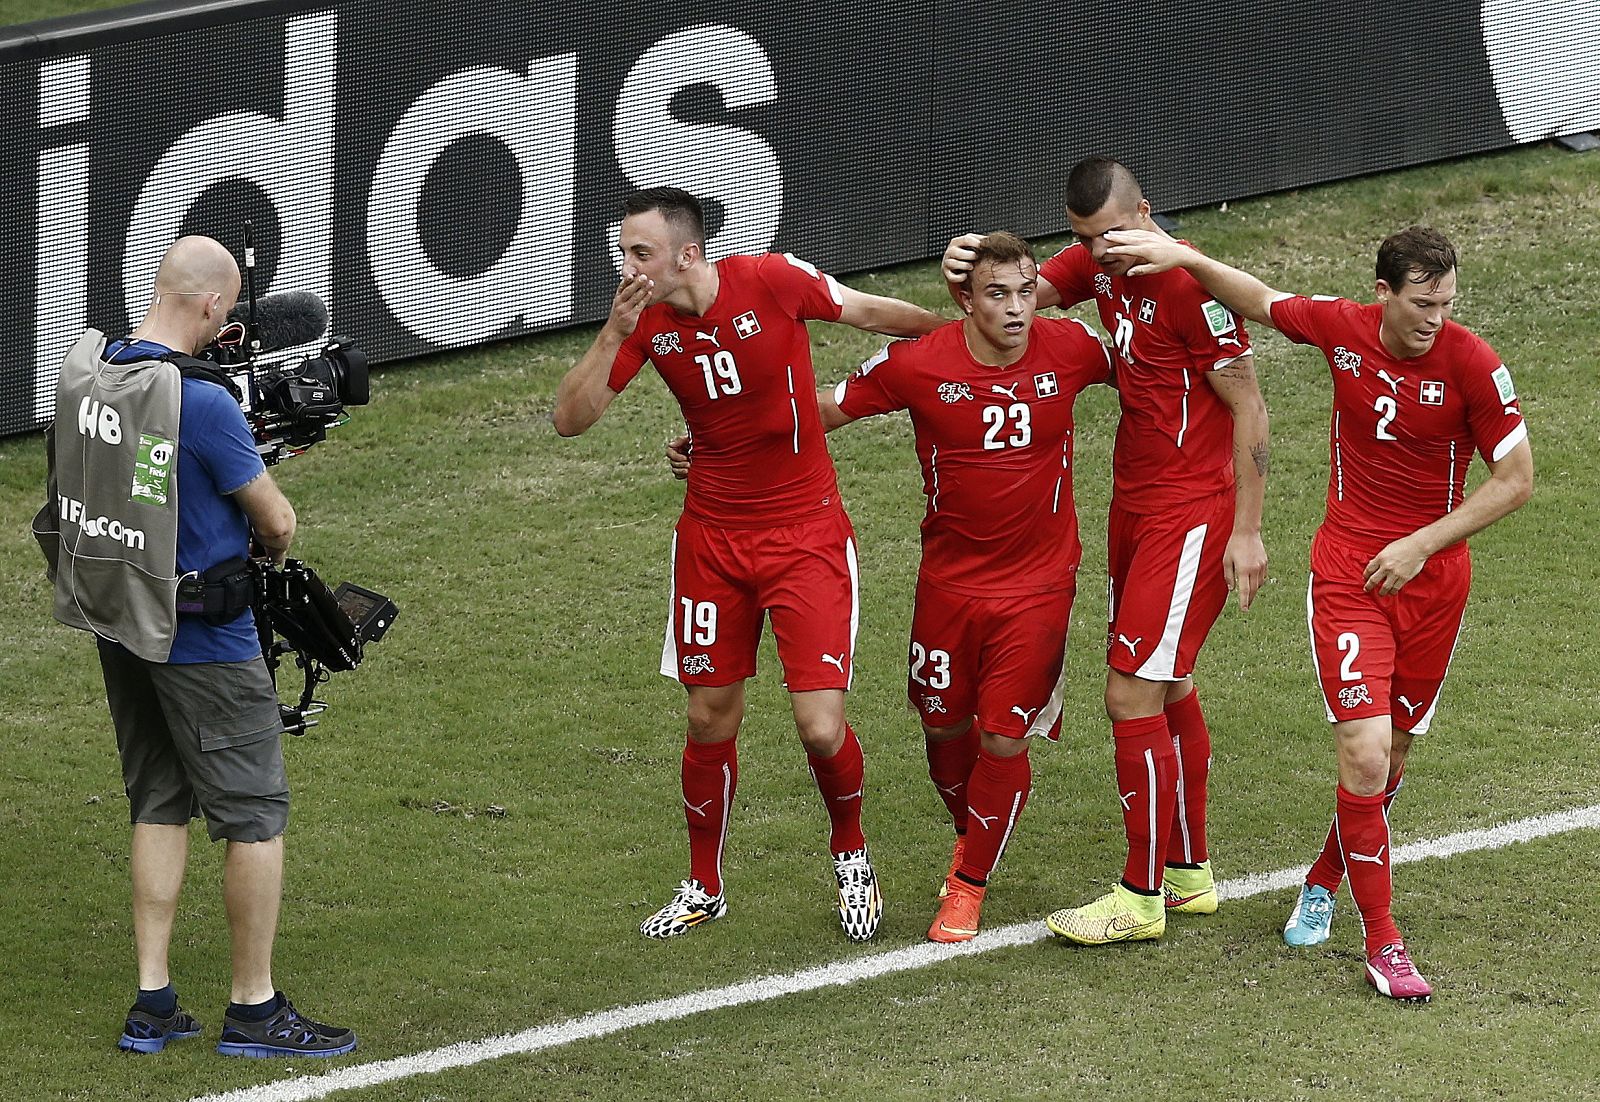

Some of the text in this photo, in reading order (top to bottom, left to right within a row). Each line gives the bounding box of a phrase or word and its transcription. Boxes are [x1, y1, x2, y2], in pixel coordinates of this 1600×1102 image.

[694, 350, 742, 400] 19
[982, 402, 1031, 450] 23
[1373, 395, 1398, 441] 2
[153, 449, 166, 462] 41
[680, 596, 718, 646] 19
[911, 641, 951, 690] 23
[1337, 631, 1363, 682] 2
